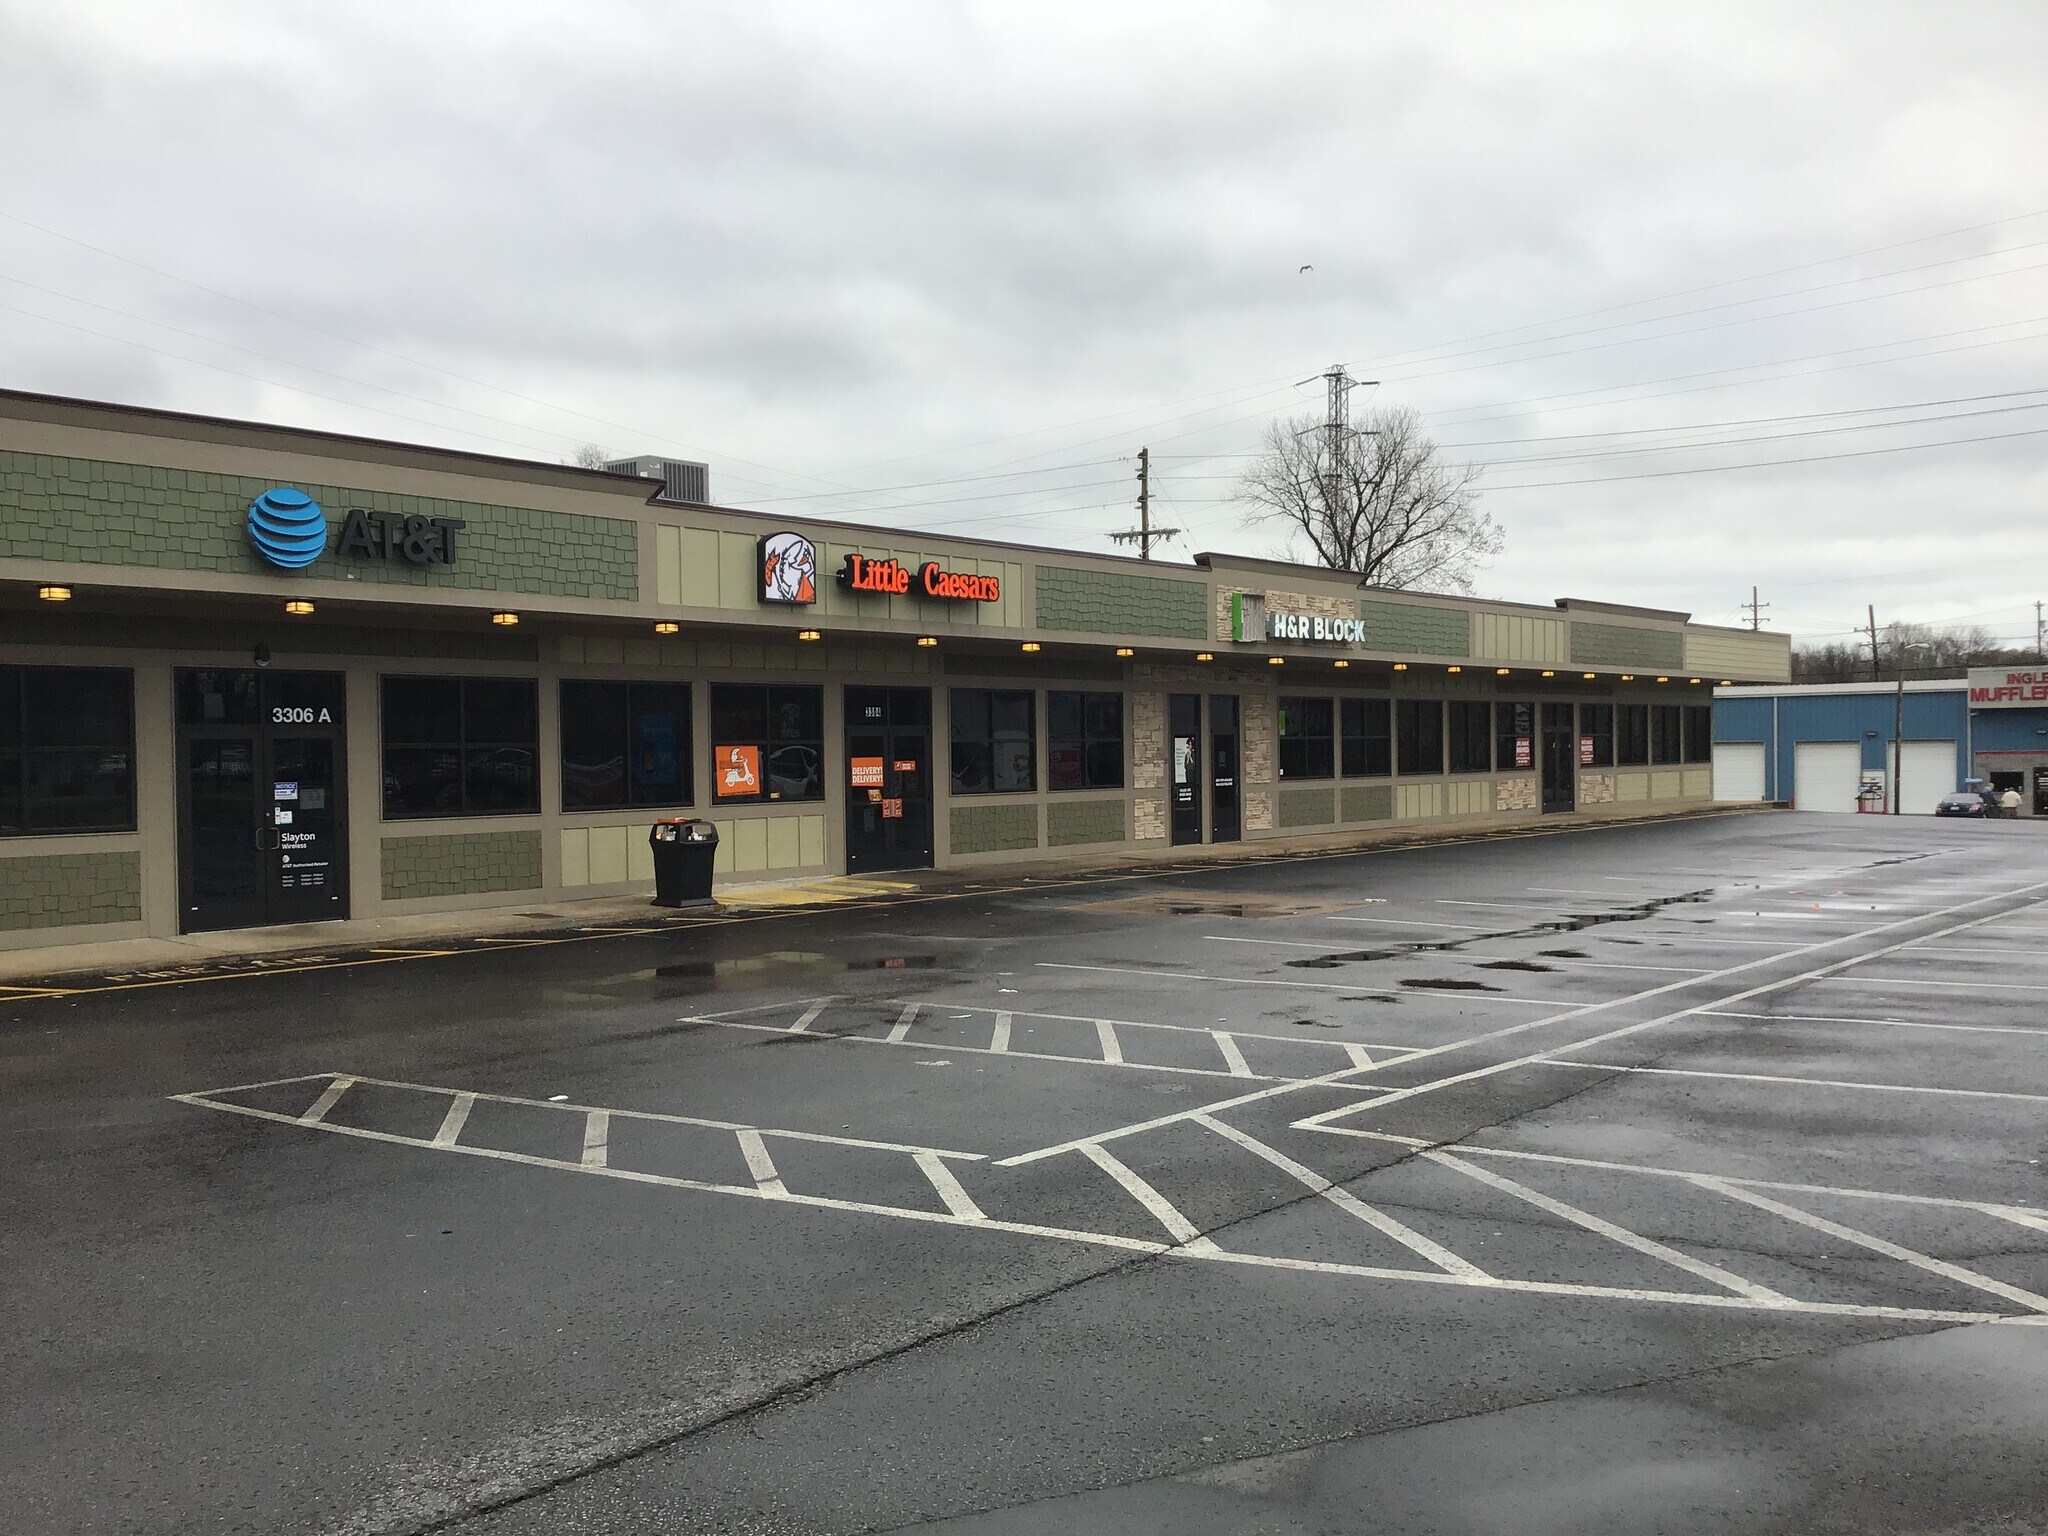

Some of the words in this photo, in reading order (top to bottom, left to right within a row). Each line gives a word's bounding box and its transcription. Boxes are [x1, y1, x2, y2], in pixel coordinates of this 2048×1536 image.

[336, 509, 466, 564] AT&T
[850, 555, 909, 594] Little
[924, 561, 1000, 602] Caesars
[1274, 614, 1310, 639] H&R
[1313, 617, 1366, 642] BLOCK
[272, 707, 314, 723] 3306
[318, 707, 332, 723] A
[852, 766, 883, 775] DELIVERY!
[852, 775, 884, 783] DELIVERY!
[281, 832, 316, 844] Slayton
